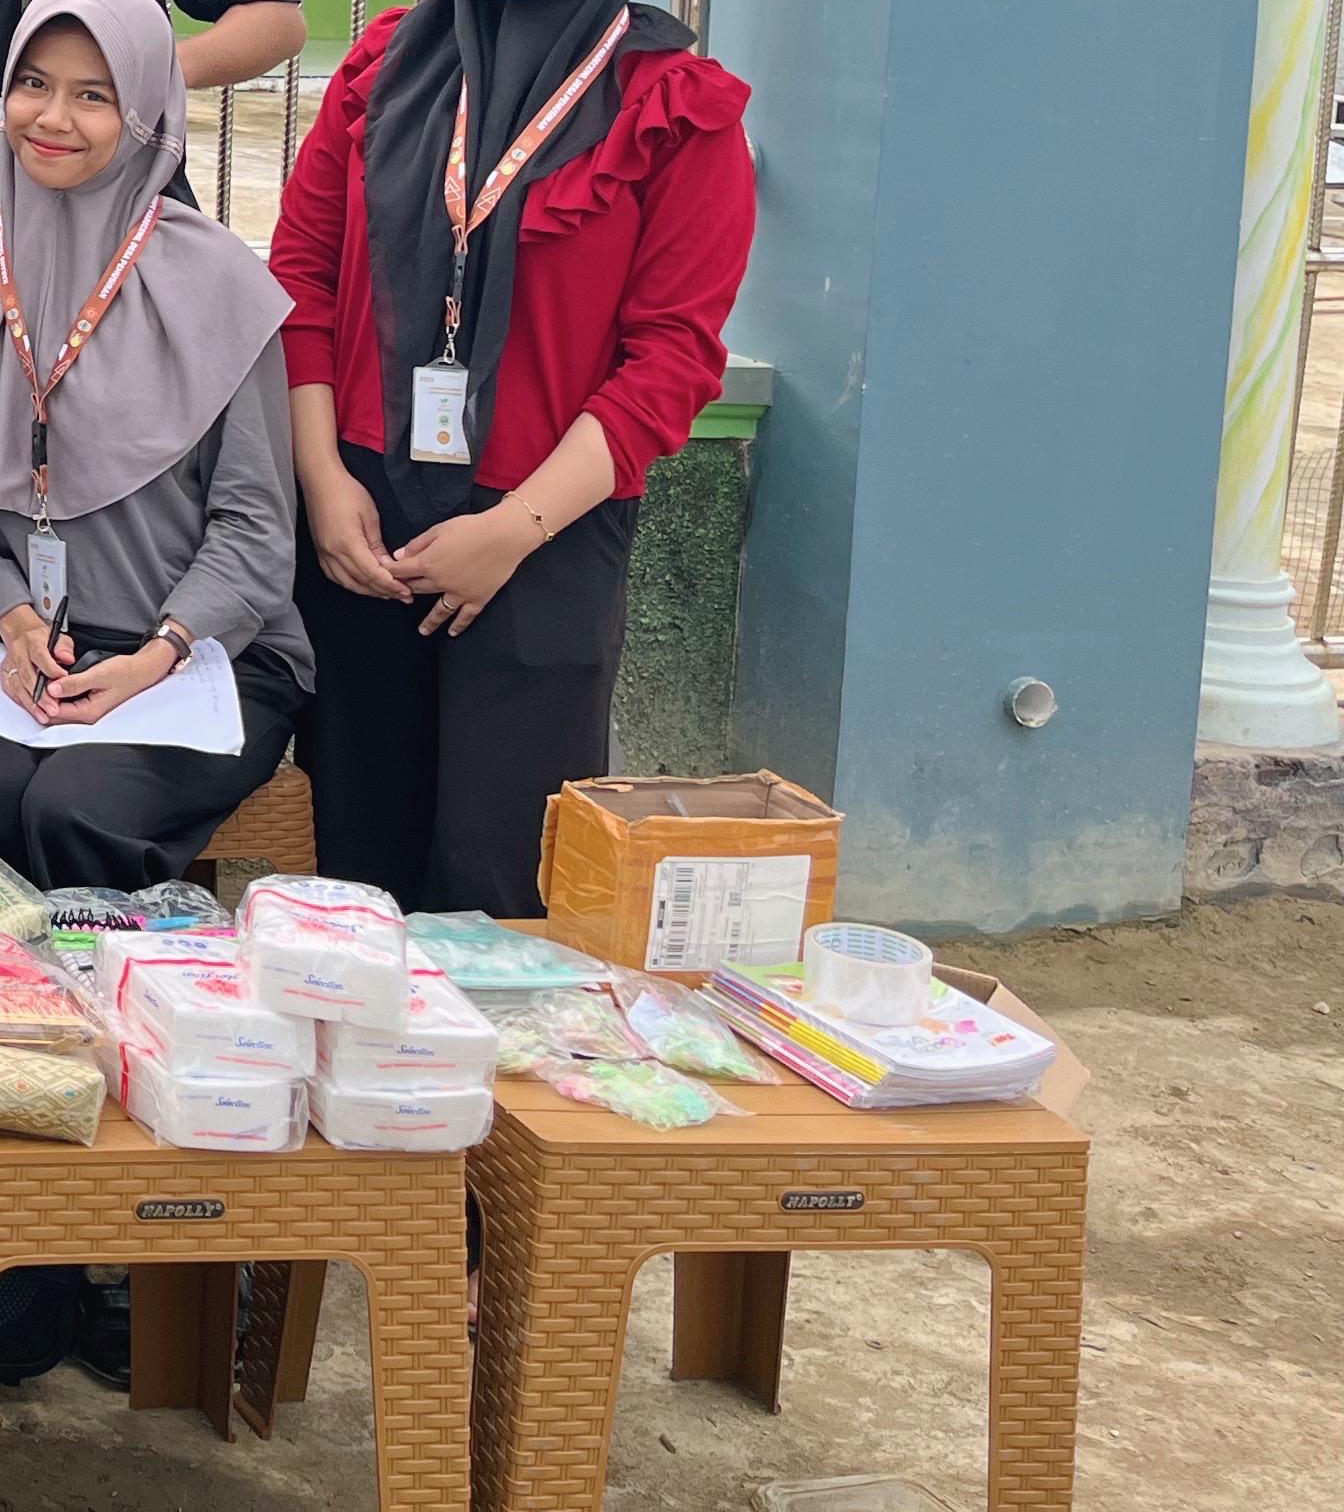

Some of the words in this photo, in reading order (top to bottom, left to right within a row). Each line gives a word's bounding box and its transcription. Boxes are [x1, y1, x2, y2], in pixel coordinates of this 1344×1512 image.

[565, 77, 583, 97] DESA
[141, 1201, 215, 1218] NAPOLLY
[786, 1194, 856, 1209] NAPOLLY
